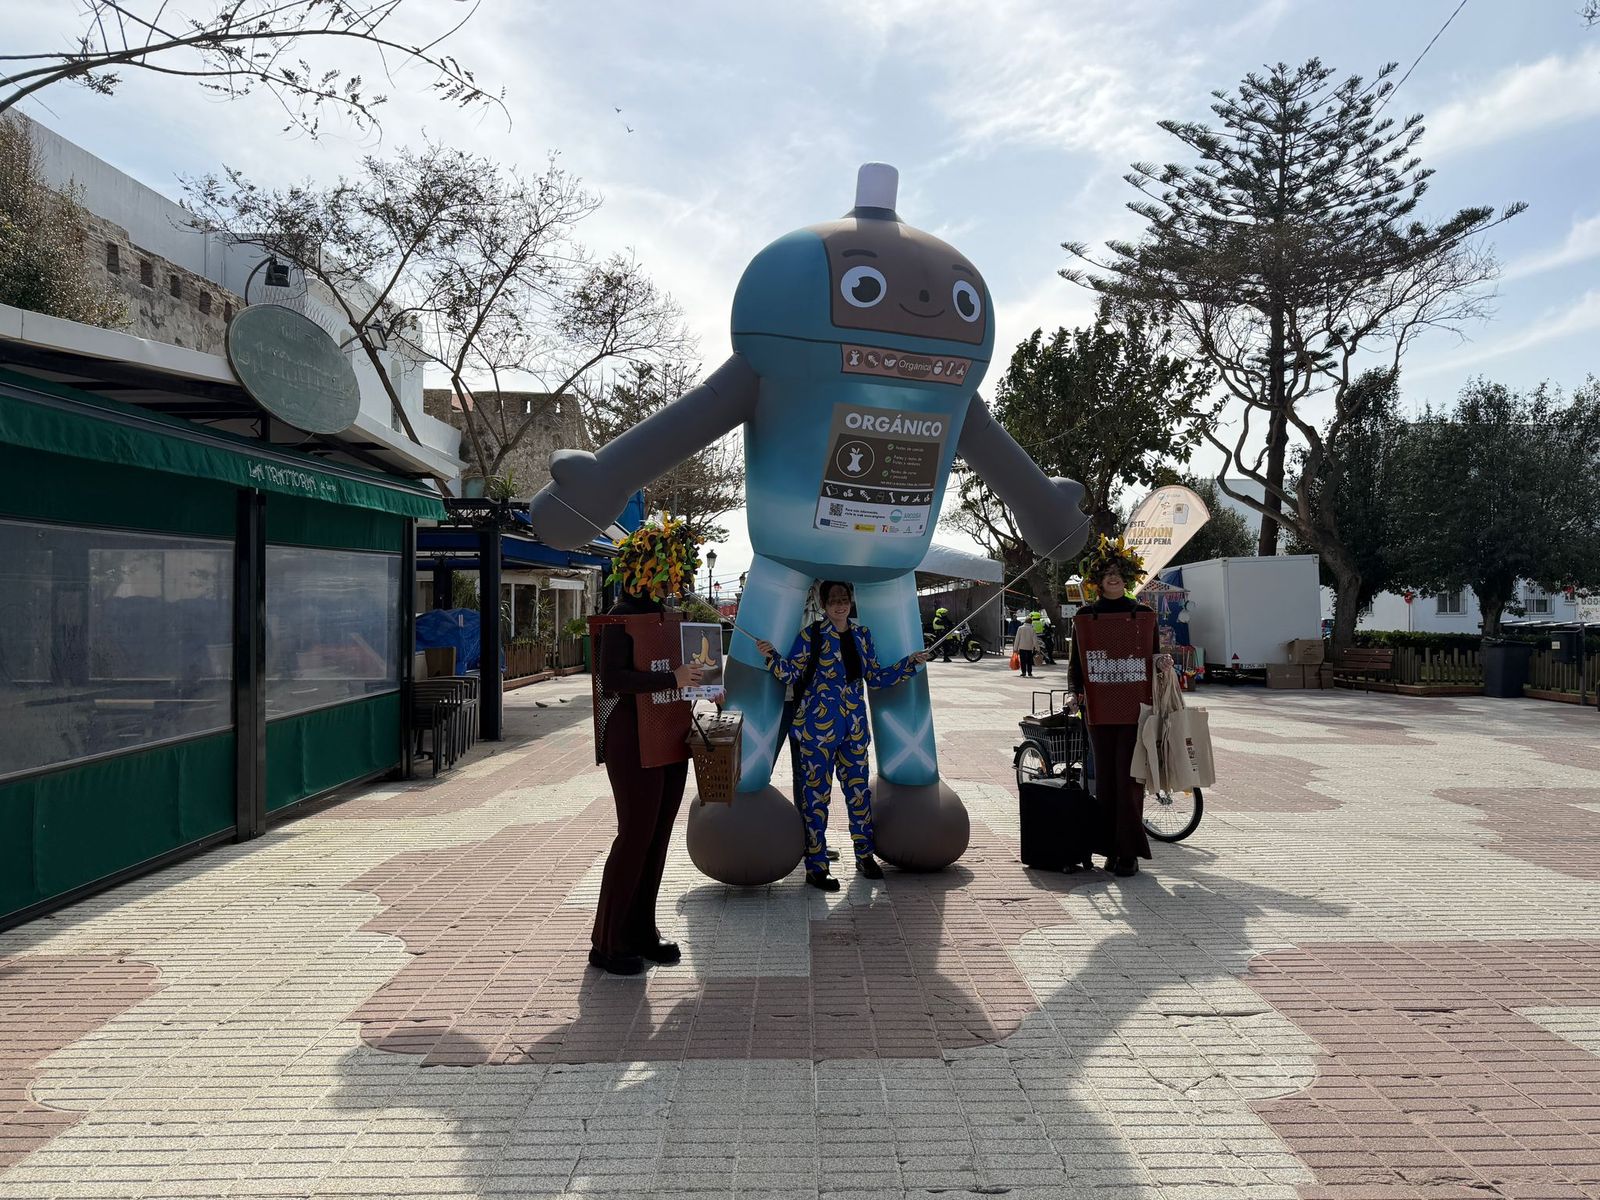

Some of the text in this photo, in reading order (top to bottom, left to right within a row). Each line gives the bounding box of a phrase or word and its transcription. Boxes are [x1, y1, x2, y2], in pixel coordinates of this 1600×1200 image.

[845, 412, 942, 437] ORGÁNICO
[247, 460, 265, 481] LA
[1130, 520, 1145, 528] ESTE
[1128, 538, 1143, 546] VALE
